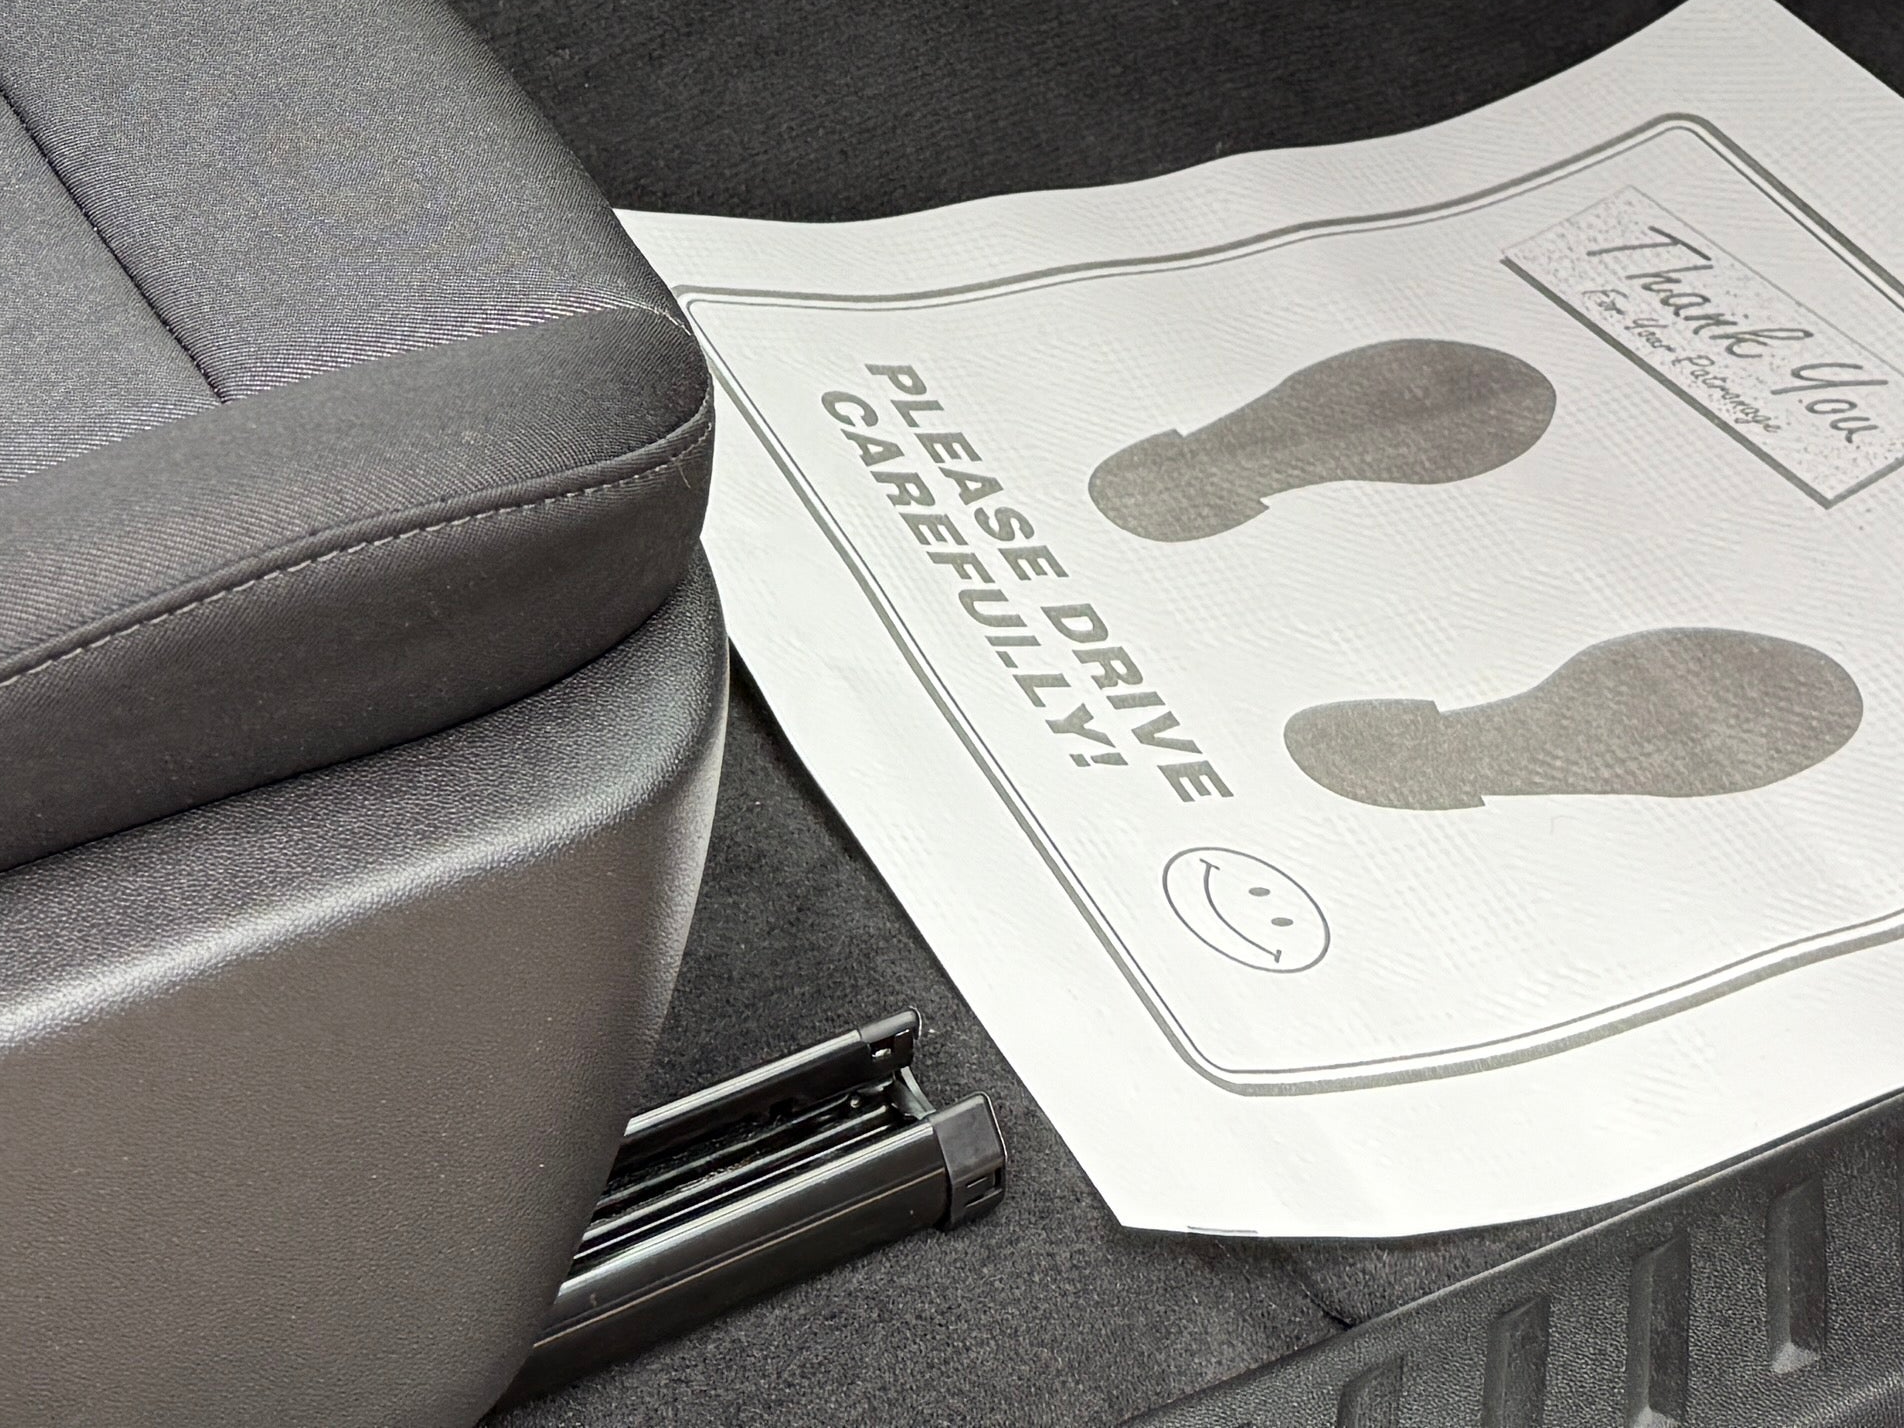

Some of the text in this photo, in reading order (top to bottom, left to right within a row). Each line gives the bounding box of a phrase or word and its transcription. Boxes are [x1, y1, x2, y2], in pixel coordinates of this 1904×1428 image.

[1581, 288, 1782, 435] For Your Patronage
[1586, 225, 1889, 444] Thank You
[821, 391, 1129, 767] CAREFULLY!
[864, 363, 1234, 803] PLEASE DRIVE
